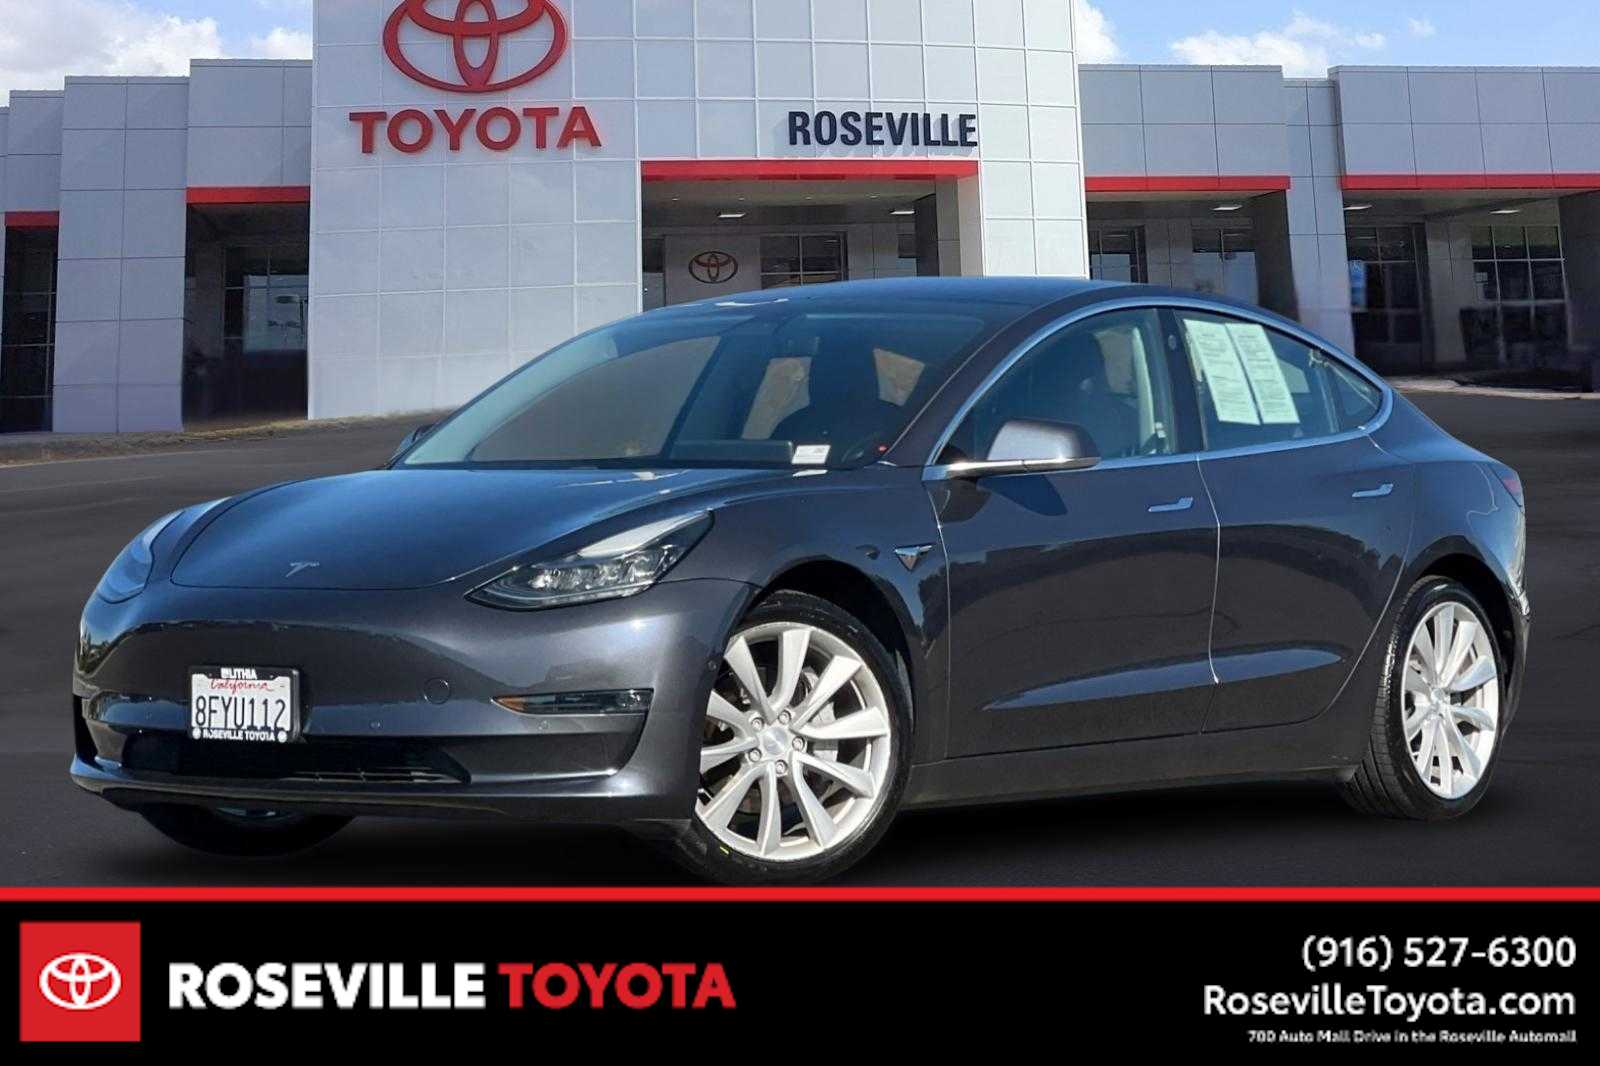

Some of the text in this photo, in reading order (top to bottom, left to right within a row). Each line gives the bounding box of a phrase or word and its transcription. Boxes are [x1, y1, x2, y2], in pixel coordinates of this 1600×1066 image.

[349, 106, 603, 154] TOYOTA
[787, 110, 978, 147] ROSEVILLE
[210, 680, 274, 694] California
[195, 695, 286, 731] 8FYU112
[203, 729, 275, 742] ROSEVILLE TOYOTA
